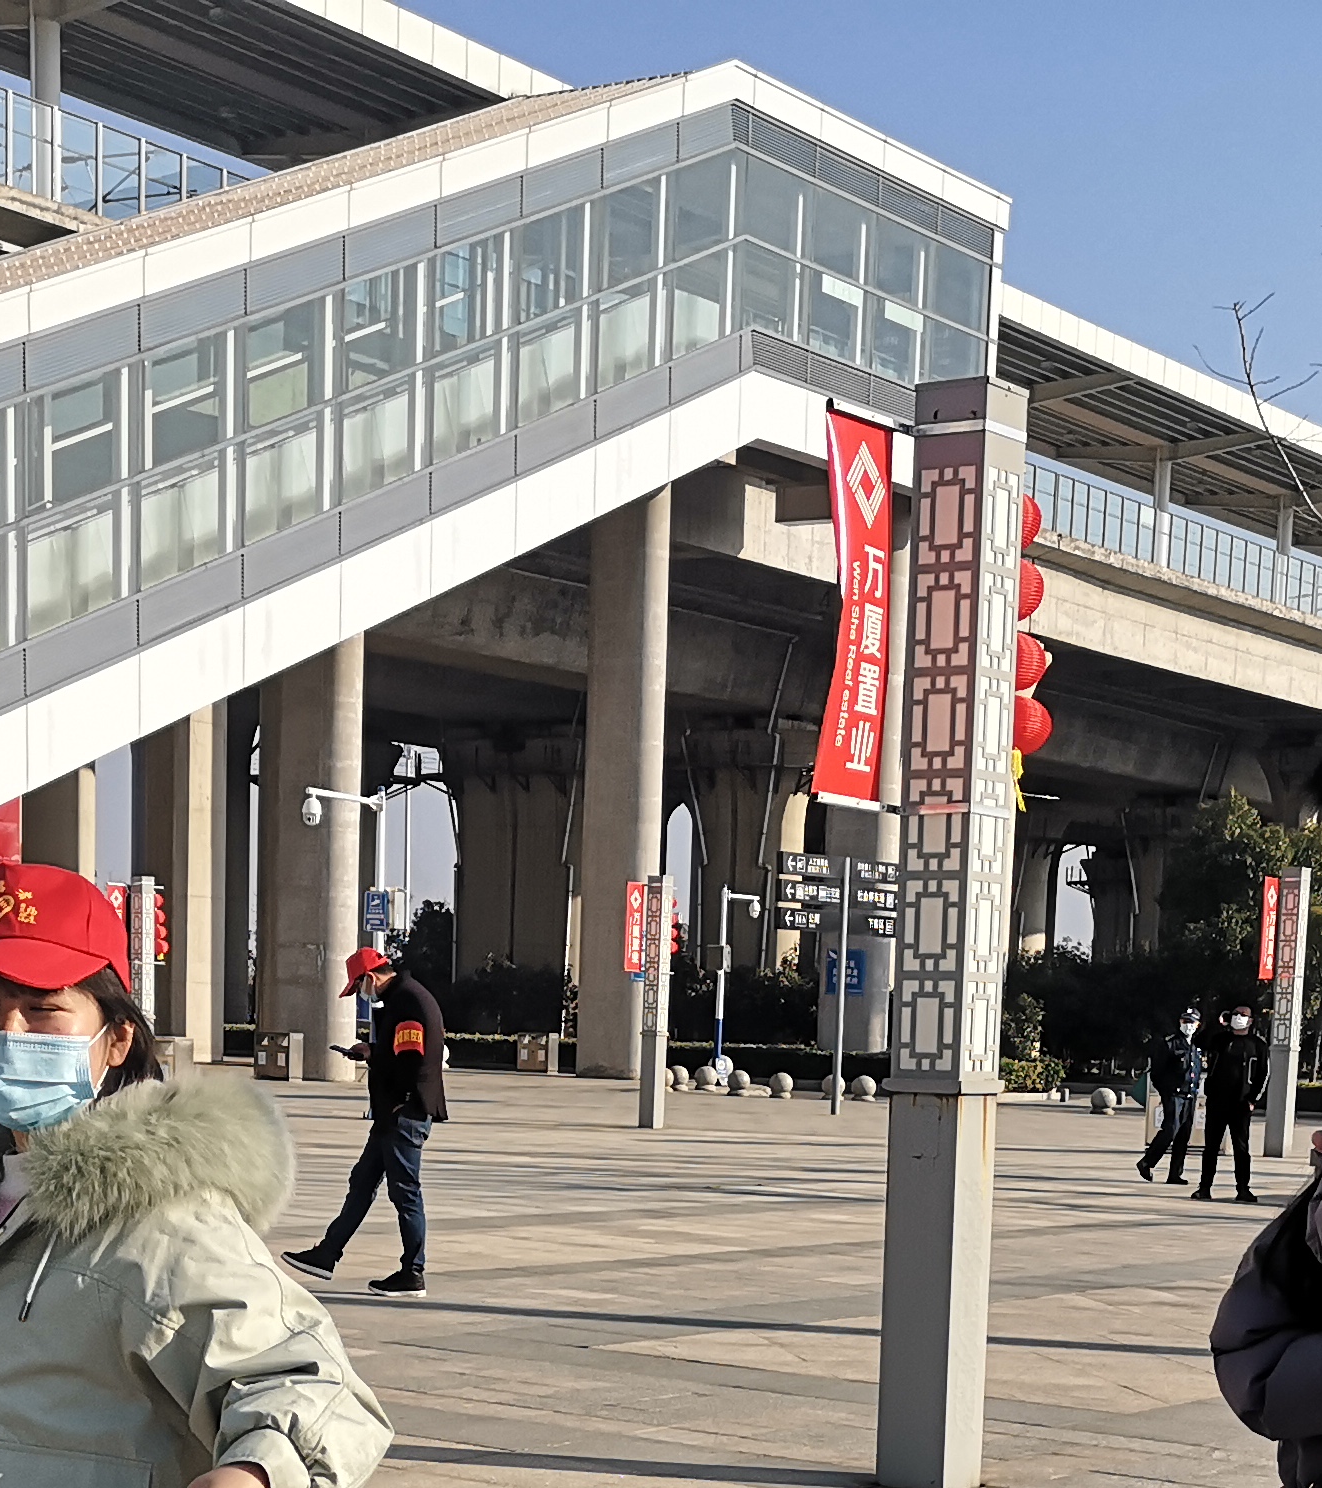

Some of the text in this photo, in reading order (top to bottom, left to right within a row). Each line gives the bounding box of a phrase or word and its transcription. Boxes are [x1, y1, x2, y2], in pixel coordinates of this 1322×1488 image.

[851, 560, 861, 601] Wan
[845, 544, 885, 773] 万厦置业
[845, 644, 857, 687] Real
[834, 688, 850, 747] estate
